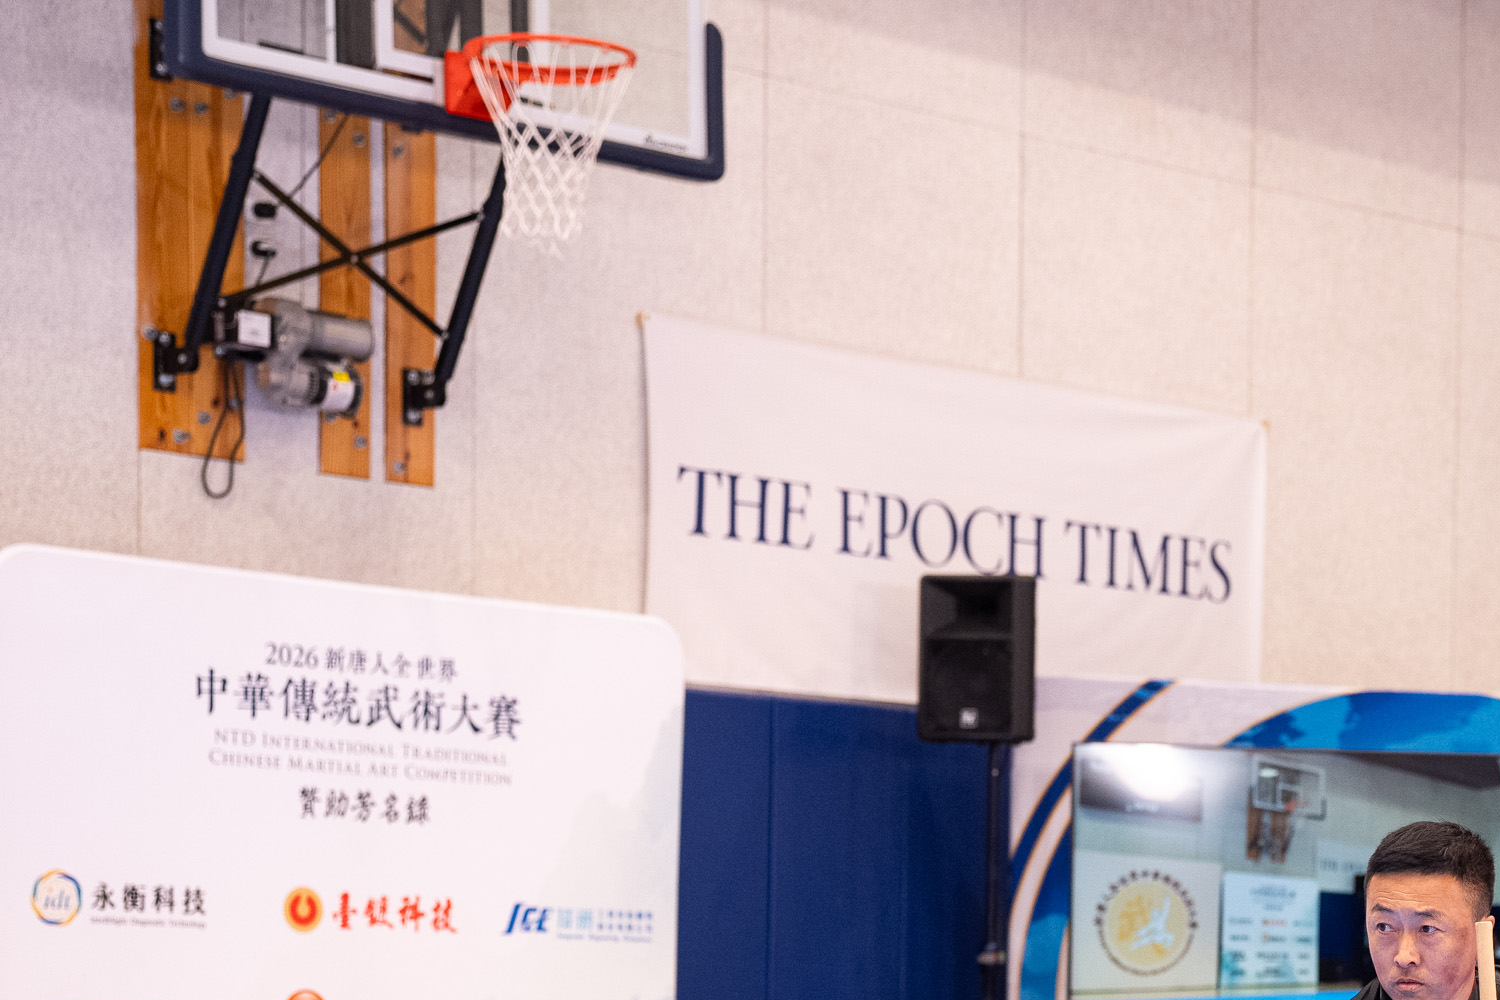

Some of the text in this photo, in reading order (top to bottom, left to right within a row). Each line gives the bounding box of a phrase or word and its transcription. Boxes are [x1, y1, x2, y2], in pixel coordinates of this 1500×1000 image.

[677, 465, 1233, 604] THE EPOCH TIMES
[266, 641, 457, 683] 2026 新唐人全世界
[196, 668, 521, 742] 中華傳統武術大賽
[214, 728, 256, 747] NTD
[92, 882, 206, 915] 永衡科技
